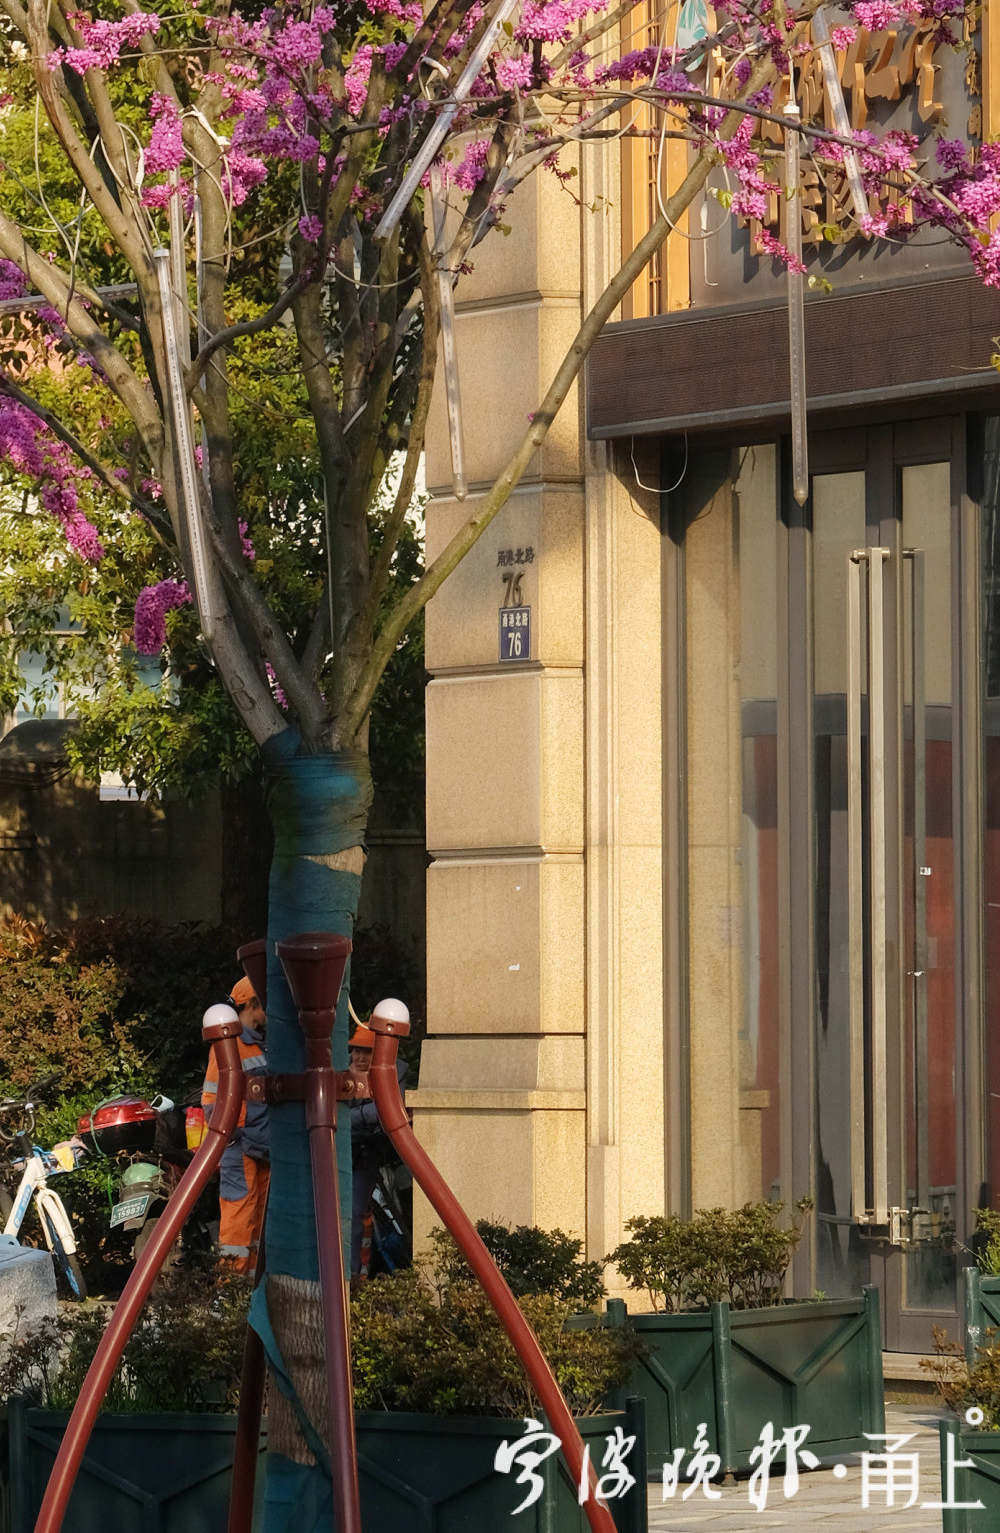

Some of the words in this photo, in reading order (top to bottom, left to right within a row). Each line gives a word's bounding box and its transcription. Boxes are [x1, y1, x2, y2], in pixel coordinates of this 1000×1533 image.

[497, 547, 535, 567] 甬港北路
[502, 571, 525, 608] 76
[502, 612, 529, 628] 甬港北路
[507, 632, 522, 657] 76
